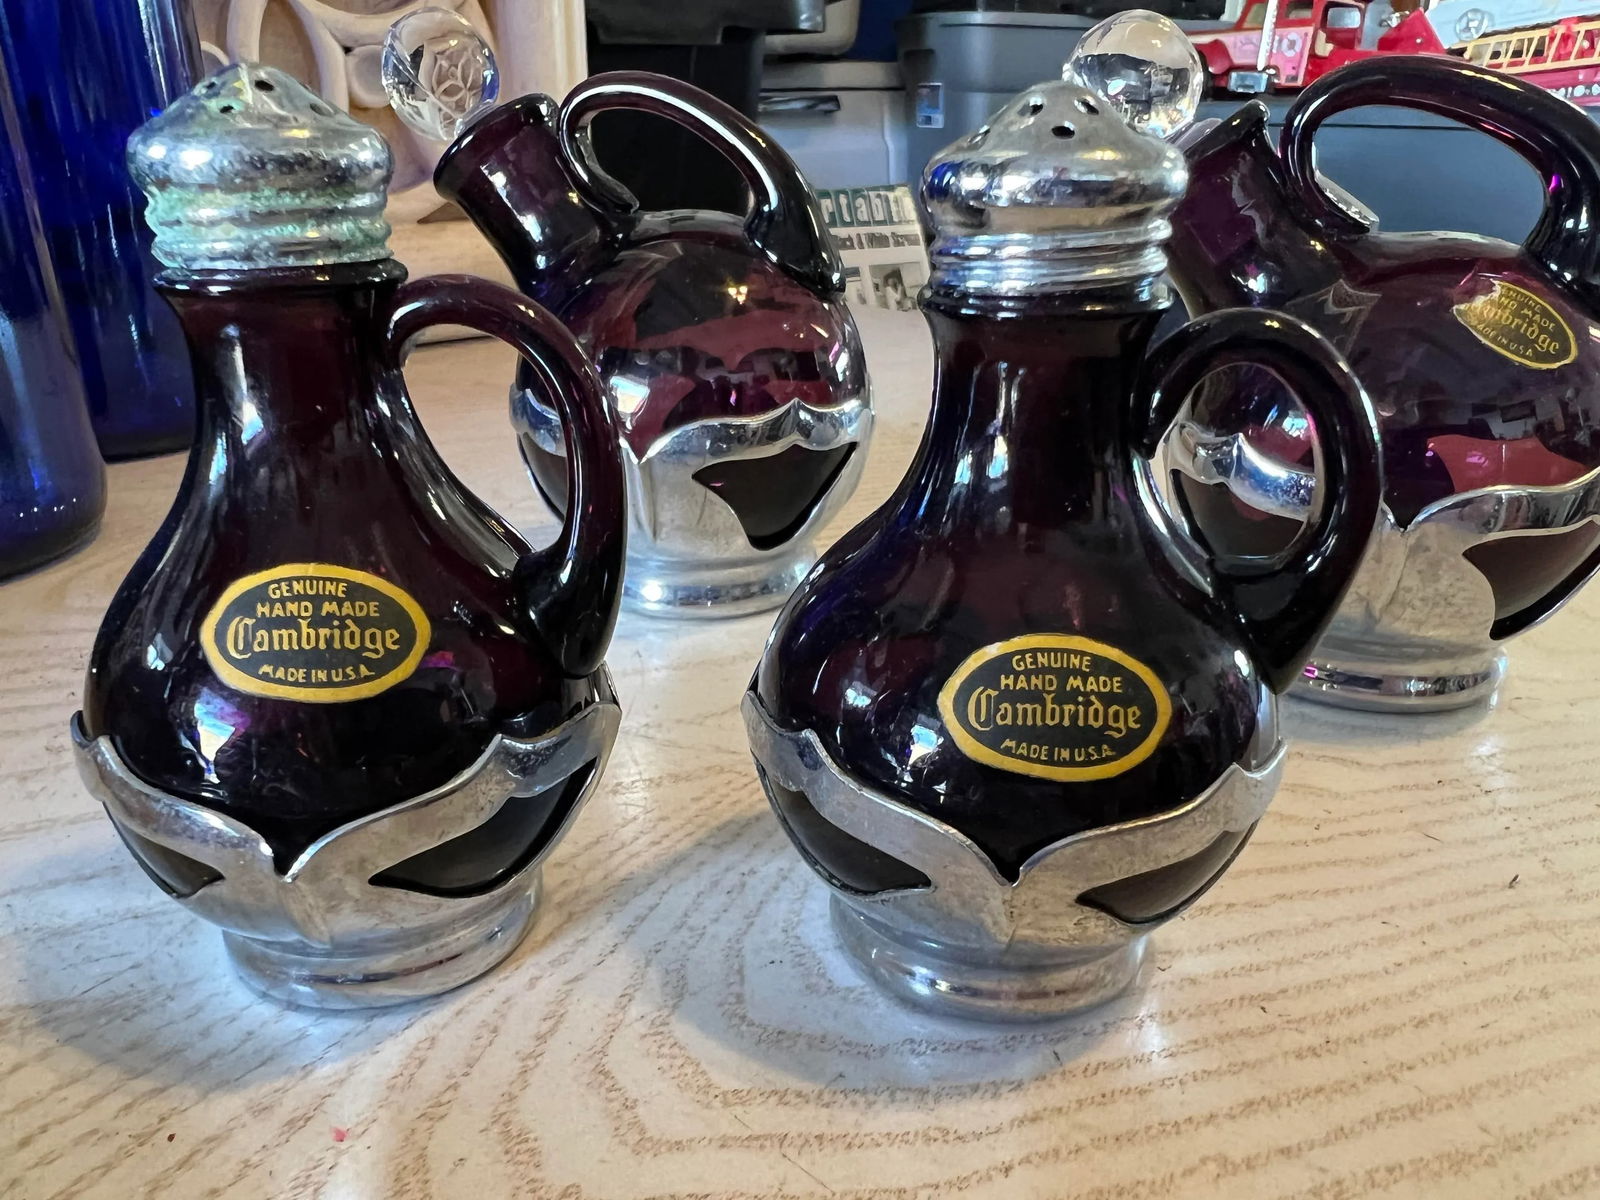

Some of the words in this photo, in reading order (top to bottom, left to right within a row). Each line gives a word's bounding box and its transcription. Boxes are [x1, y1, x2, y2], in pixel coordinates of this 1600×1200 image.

[1521, 308, 1555, 332] MADE
[1497, 335, 1508, 344] IN
[268, 579, 348, 599] GENUINE
[256, 601, 313, 618] HAND
[321, 601, 380, 617] MADE
[226, 615, 400, 659] Cambridge
[1012, 652, 1092, 672] GENUINE
[258, 664, 307, 682] MADE
[311, 669, 328, 683] IN
[1000, 674, 1058, 691] HAND
[1066, 676, 1123, 693] MADE
[967, 686, 1142, 738] Cambridge
[1001, 738, 1049, 761] MADE
[1054, 747, 1070, 762] IN
